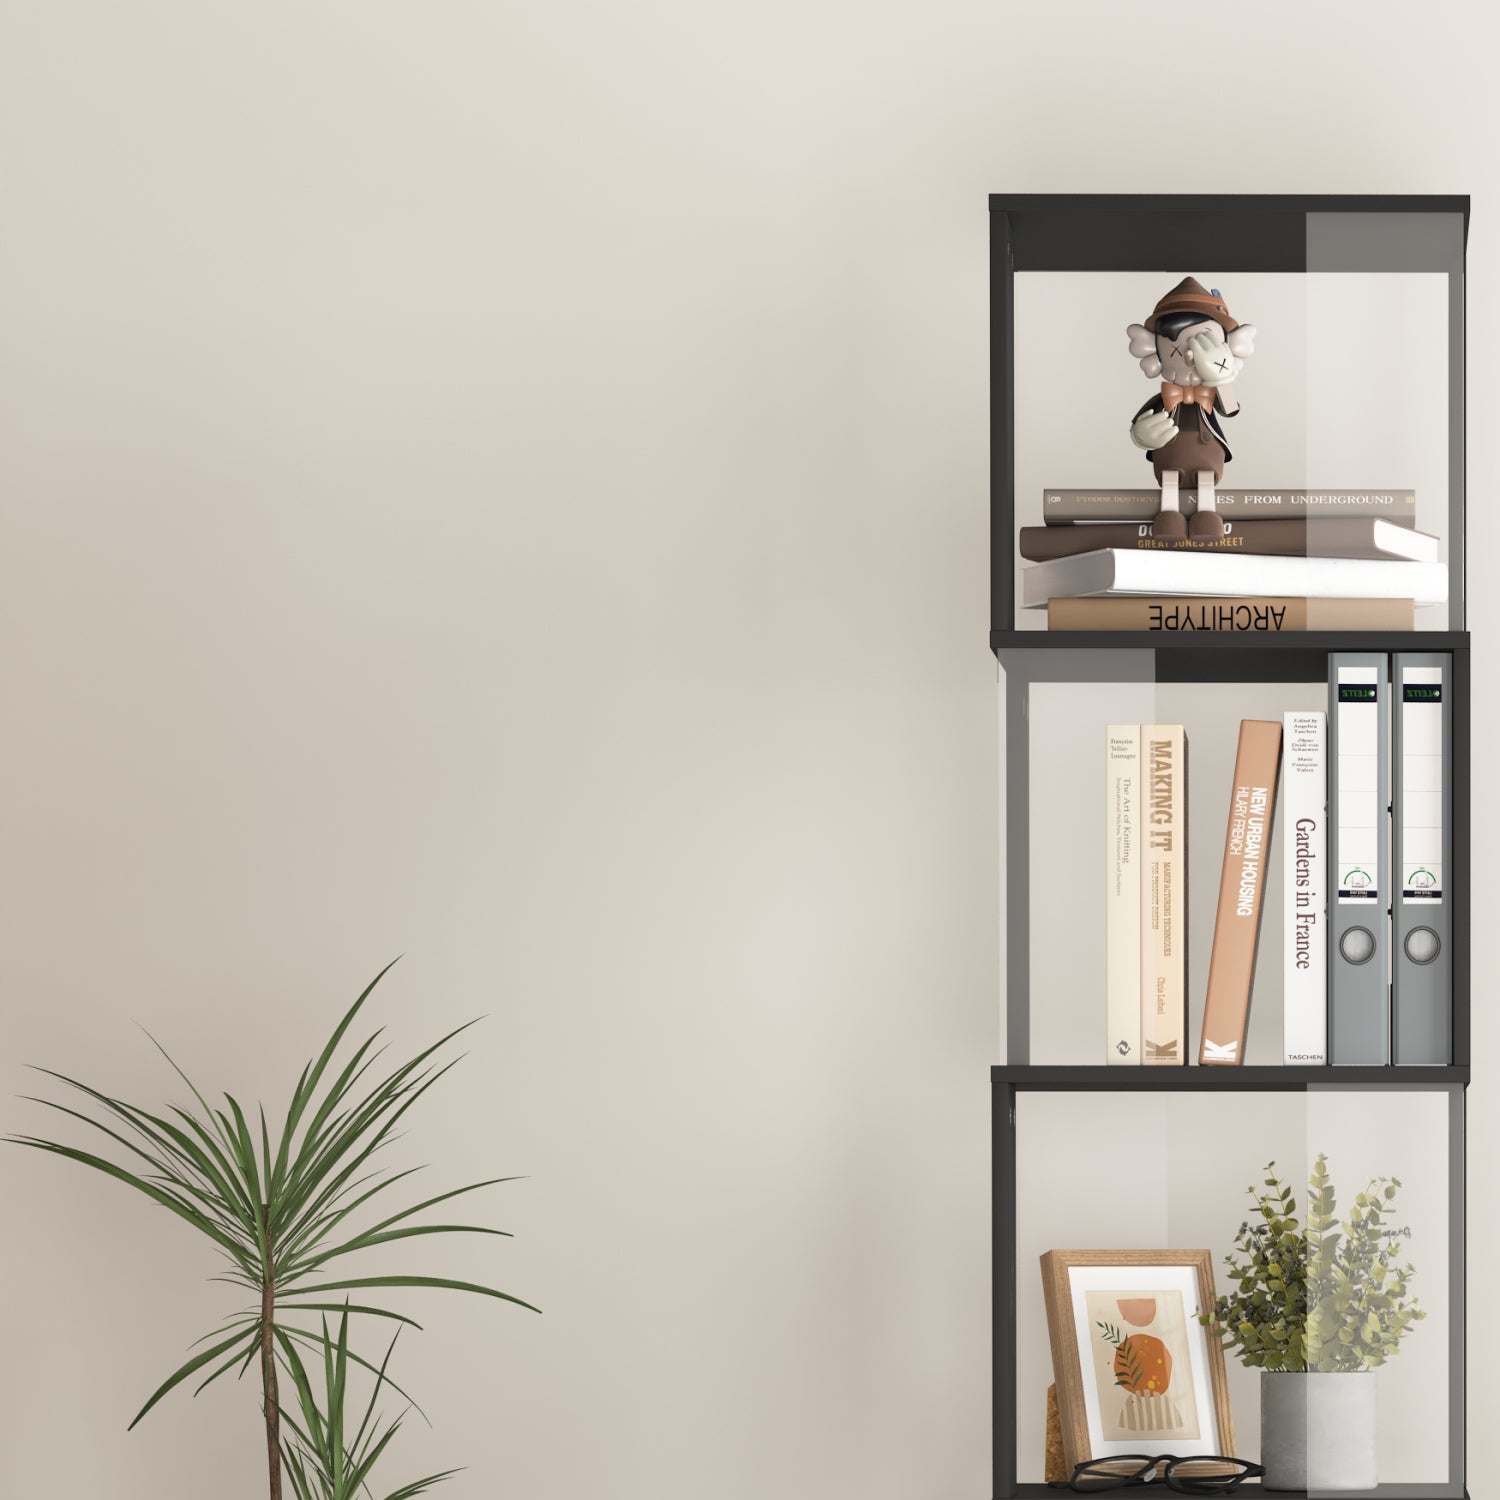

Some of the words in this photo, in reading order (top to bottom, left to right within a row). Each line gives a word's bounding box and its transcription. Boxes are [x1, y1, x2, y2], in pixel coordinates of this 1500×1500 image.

[1188, 495, 1235, 505] NES
[1244, 495, 1282, 505] FROM
[1290, 495, 1394, 505] UNDERGROUND
[1148, 605, 1287, 631] ARCHITYPE
[1123, 778, 1131, 795] The
[1150, 740, 1172, 825] MAKING
[1123, 797, 1131, 812] Art
[1233, 786, 1250, 818] HILARY
[1249, 787, 1268, 815] NEW
[1123, 814, 1131, 825] of
[1121, 826, 1131, 864] Knitting
[1150, 830, 1172, 852] IT
[1229, 819, 1246, 856] FRENCH
[1244, 817, 1264, 859] URBAN
[1295, 818, 1317, 887] Gardens
[1236, 861, 1259, 917] HOUSING
[1296, 891, 1316, 908] in
[1296, 912, 1317, 970] France
